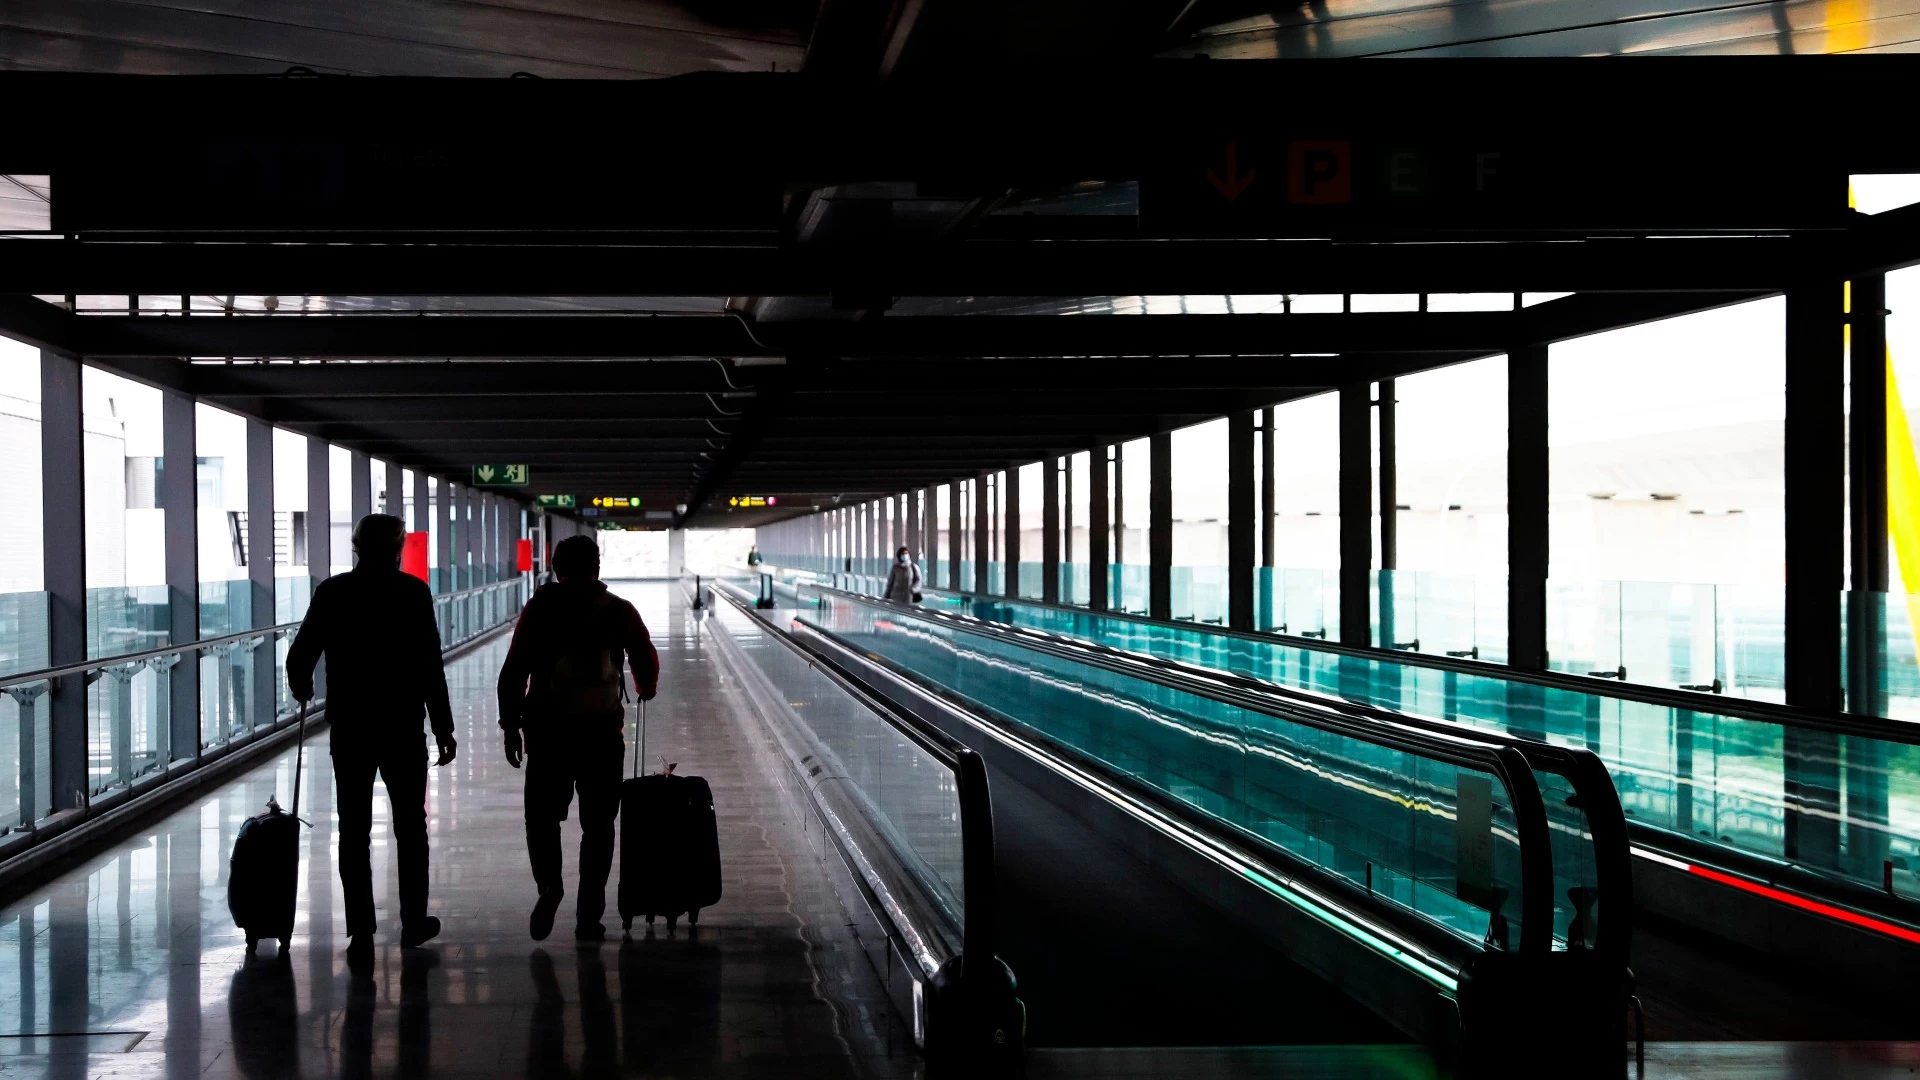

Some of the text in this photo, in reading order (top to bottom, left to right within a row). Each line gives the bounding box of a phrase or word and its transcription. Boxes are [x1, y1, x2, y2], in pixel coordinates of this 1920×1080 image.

[1303, 149, 1501, 196] P E F
